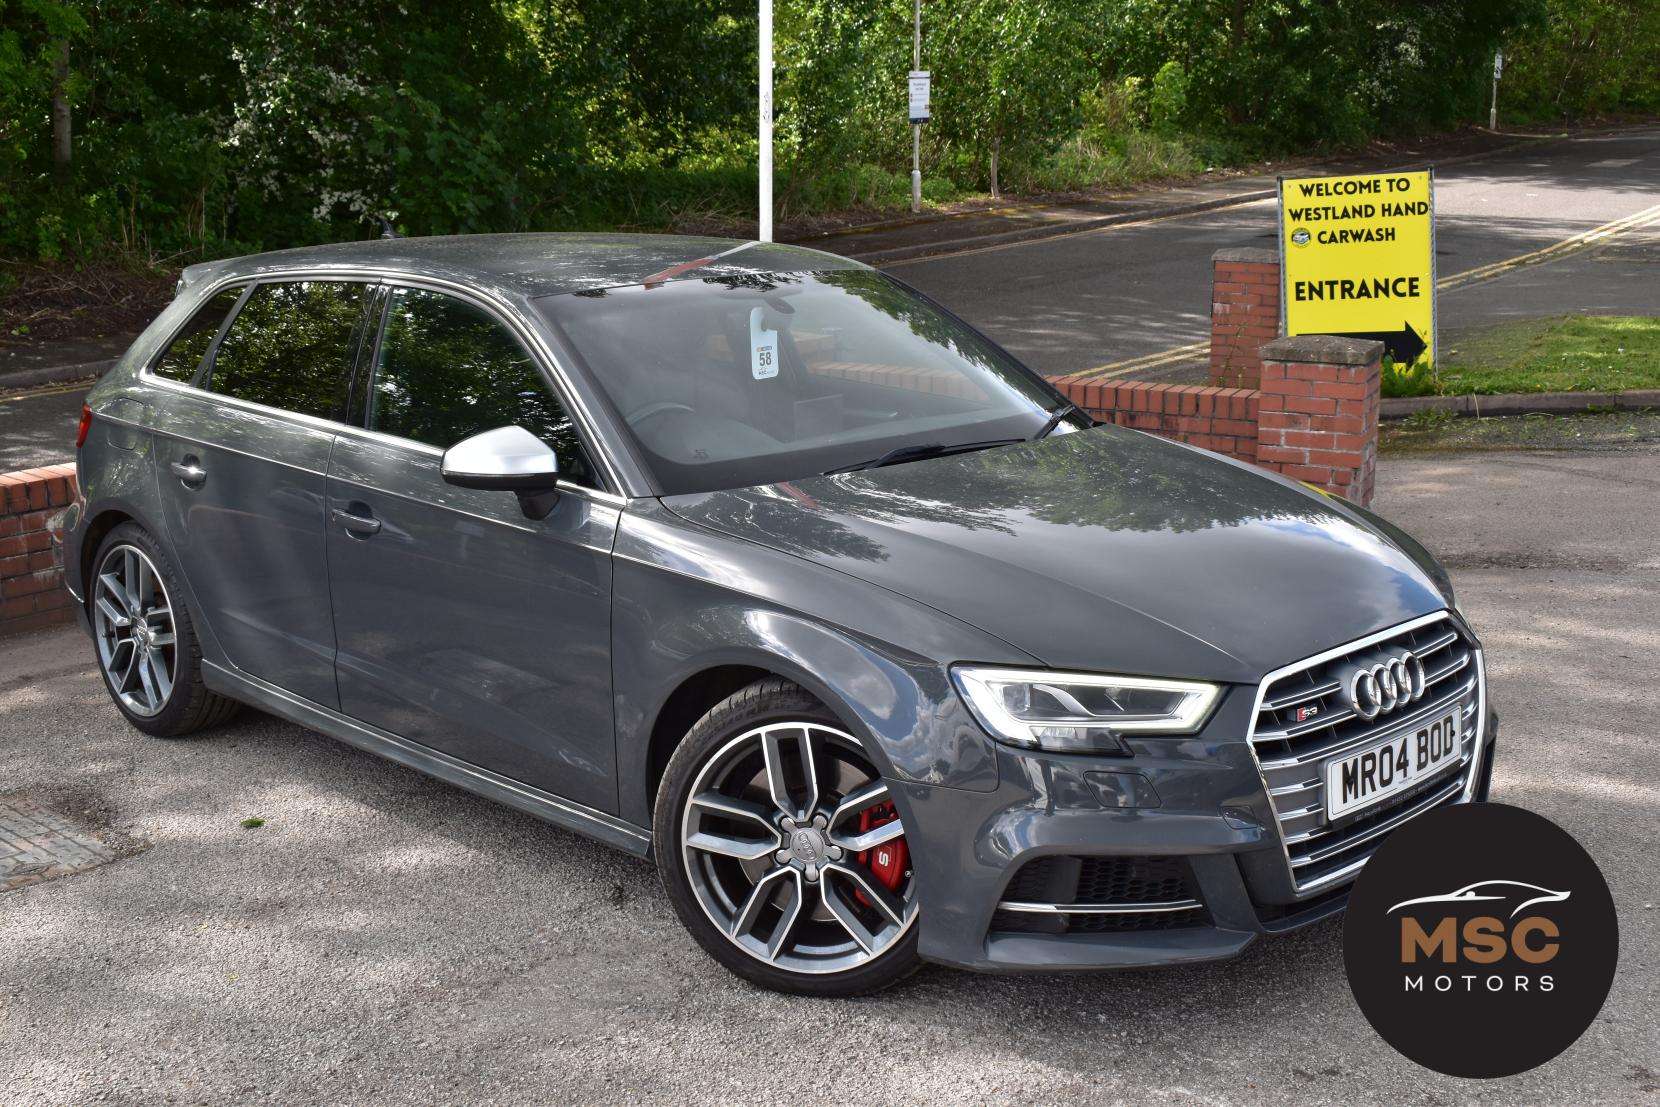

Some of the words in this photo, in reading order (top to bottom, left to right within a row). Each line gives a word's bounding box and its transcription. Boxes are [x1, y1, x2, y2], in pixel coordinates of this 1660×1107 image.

[1299, 179, 1380, 197] WELCOME
[1386, 178, 1410, 192] TO
[1288, 204, 1375, 222] WESTLAND
[1381, 201, 1429, 217] HAND
[1317, 227, 1396, 244] CARWASH
[1295, 277, 1420, 301] ENTRANCE
[760, 352, 771, 366] 58
[1342, 738, 1409, 803] MR04
[1416, 715, 1454, 772] BOD
